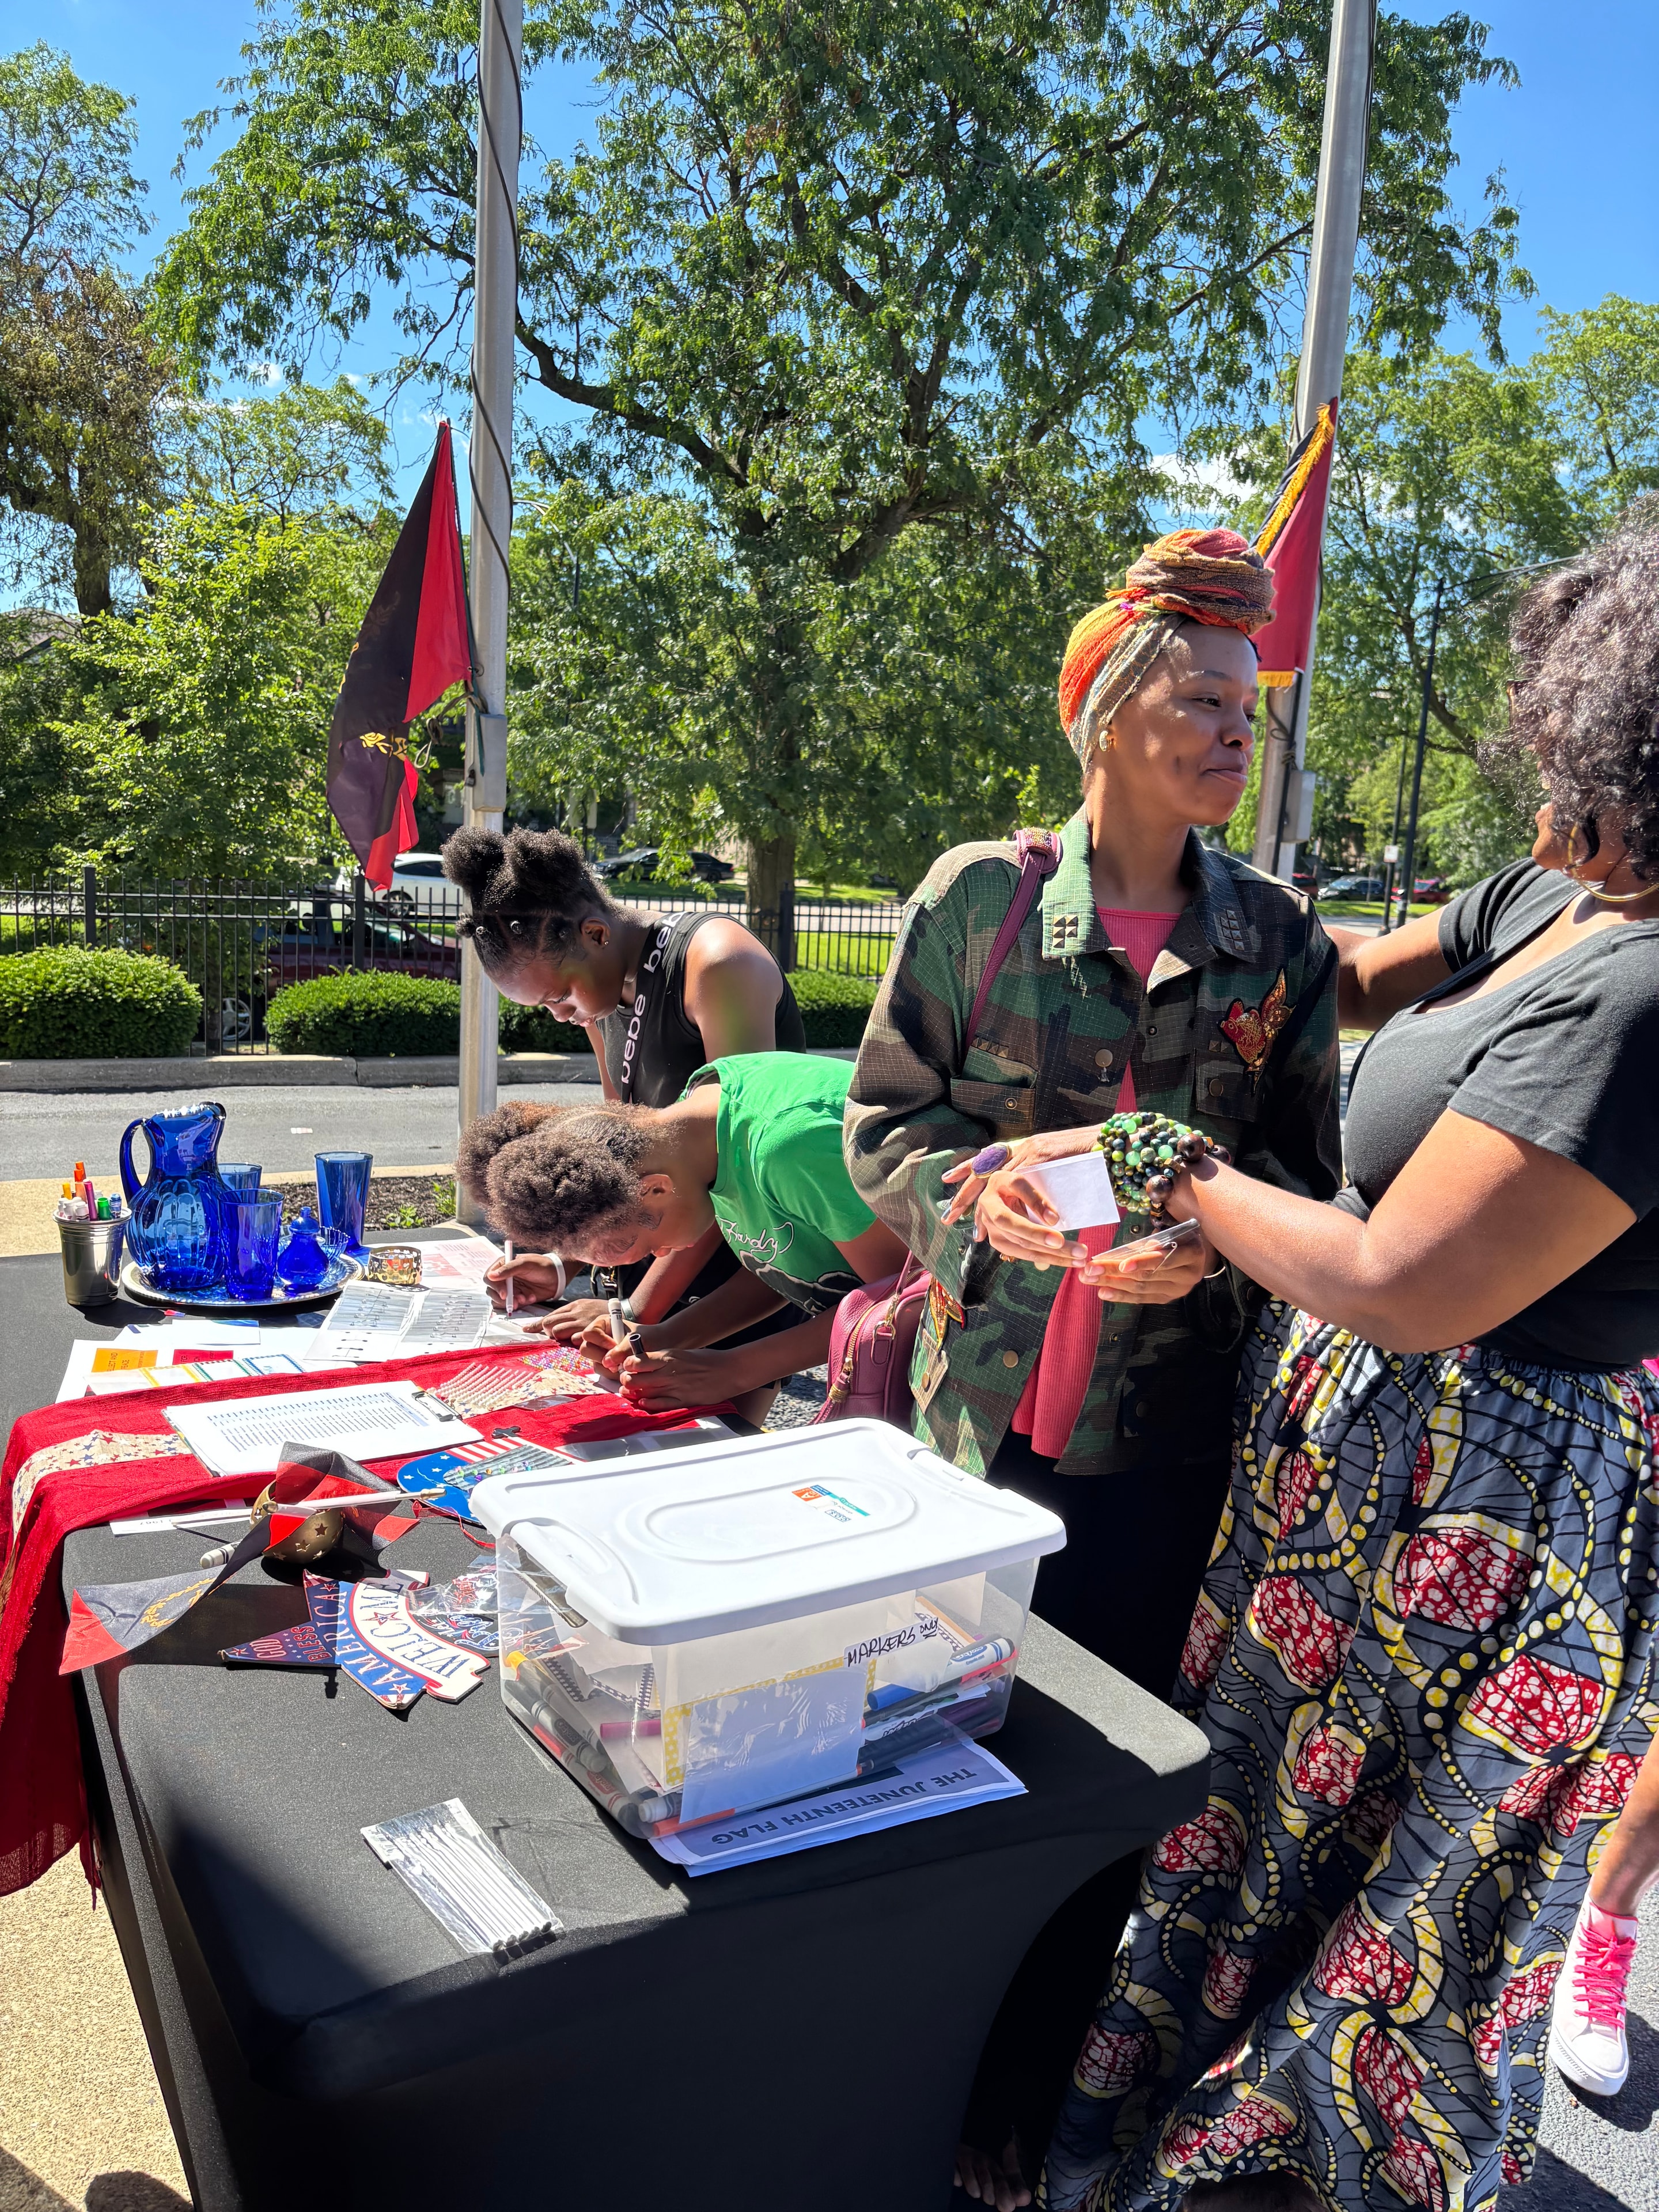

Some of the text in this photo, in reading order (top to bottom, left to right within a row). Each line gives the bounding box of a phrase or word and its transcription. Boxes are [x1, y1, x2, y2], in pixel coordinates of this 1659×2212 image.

[643, 911, 687, 973] beb
[621, 994, 646, 1085] bebe
[249, 1639, 287, 1658] GOD
[291, 1626, 332, 1662] BLESS
[314, 1591, 414, 1685] AMERICA
[847, 1617, 938, 1667] MARKERS ONLY
[711, 1767, 977, 1844] THE JUNETEENTH FLAG
